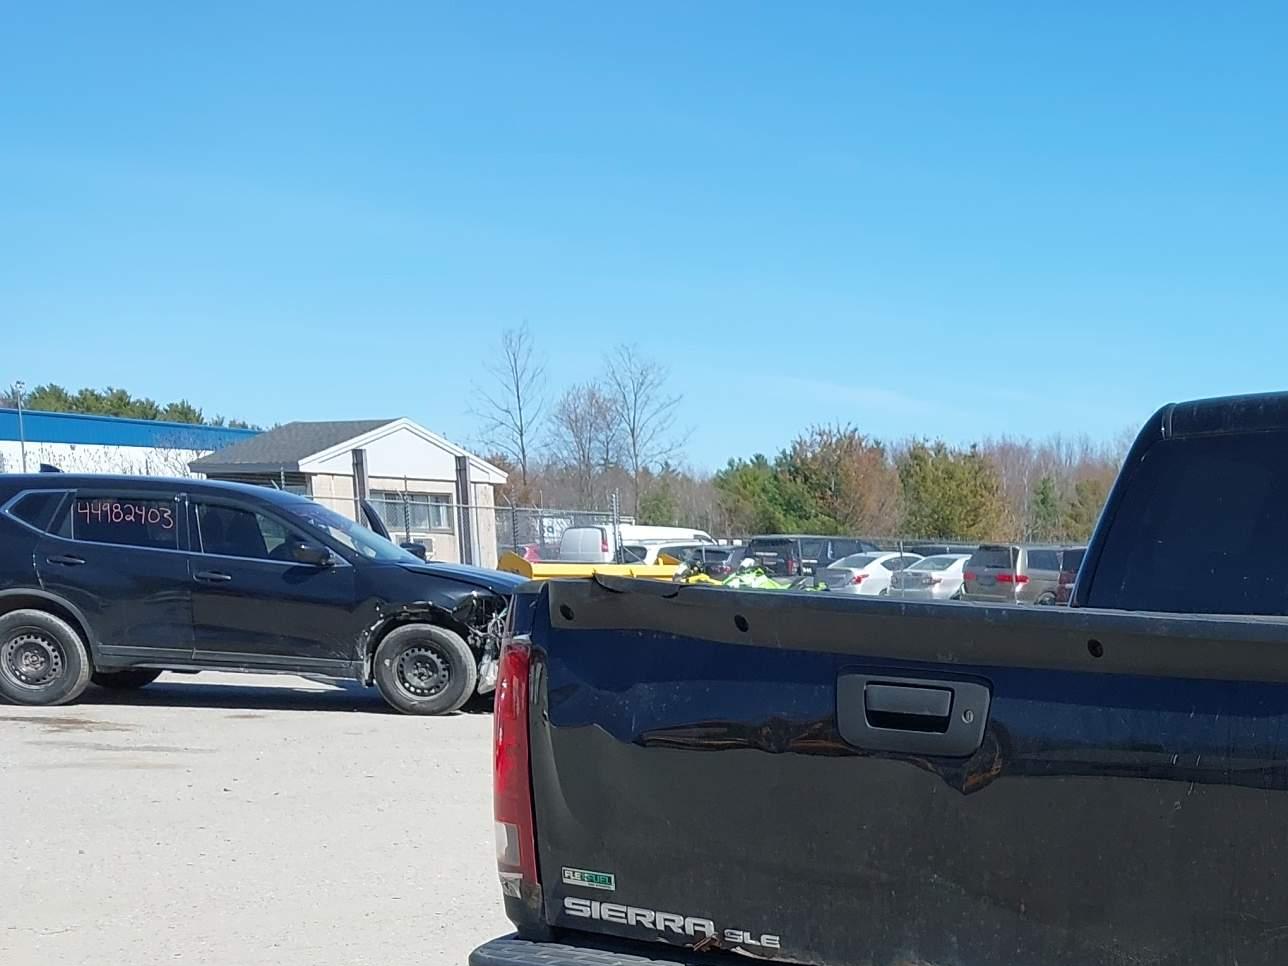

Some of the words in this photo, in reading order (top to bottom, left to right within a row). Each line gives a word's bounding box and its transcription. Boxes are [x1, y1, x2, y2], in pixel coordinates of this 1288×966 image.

[77, 501, 174, 529] 44982403
[563, 896, 716, 938] SIERRA
[723, 928, 781, 950] SLE
